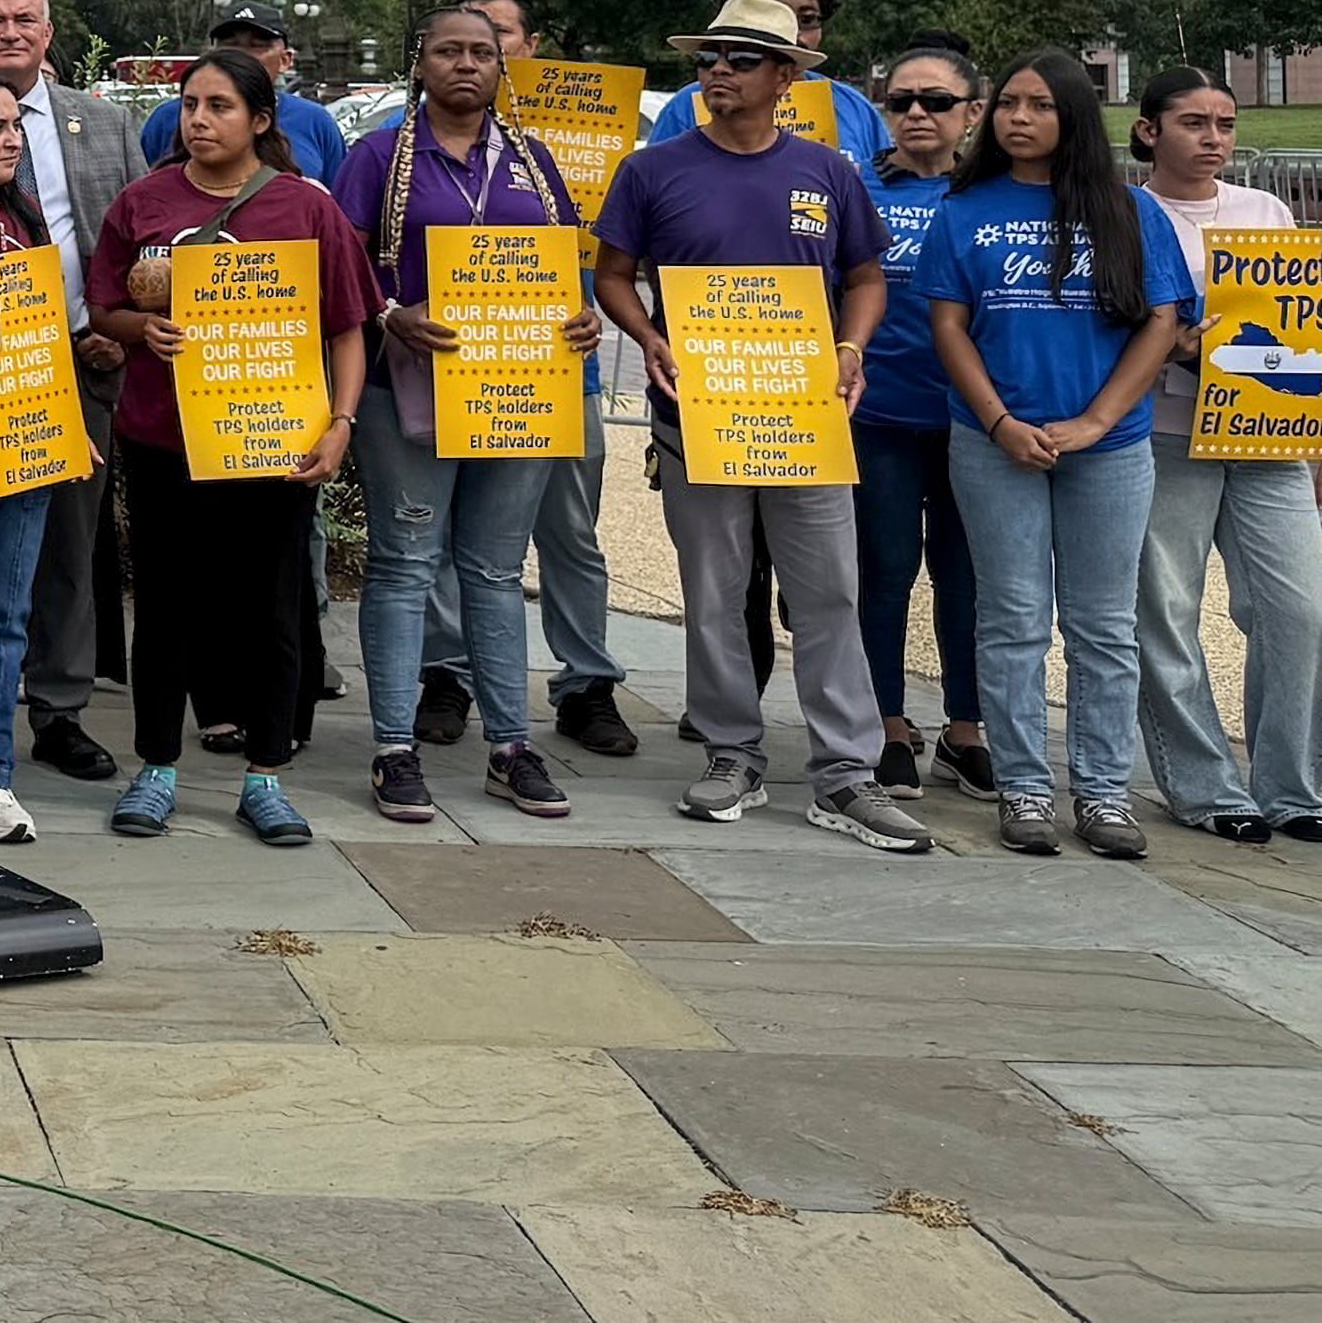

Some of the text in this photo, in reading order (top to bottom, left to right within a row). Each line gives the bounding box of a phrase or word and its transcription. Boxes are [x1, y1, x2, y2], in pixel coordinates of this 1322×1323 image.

[541, 66, 603, 85] 25 years
[535, 80, 603, 102] of calling
[543, 95, 573, 112] U.S.
[576, 98, 618, 116] home
[543, 128, 623, 154] FAMILIES
[558, 148, 605, 166] LIVES
[790, 190, 828, 206] 32BJ
[790, 218, 827, 234] SEIU
[888, 217, 920, 230] TPS
[471, 234, 536, 252] 25 years
[1004, 233, 1039, 245] TPS
[213, 251, 276, 270] 25 years
[469, 250, 539, 269] of calling
[1211, 249, 1322, 286] Protec
[211, 265, 280, 285] of calling
[452, 267, 558, 283] the U.S. home
[706, 274, 776, 291] 25 years
[17, 293, 47, 308] home
[194, 283, 297, 303] the U.S. home
[706, 289, 781, 307] of calling
[444, 304, 569, 322] OUR FAMILIES
[690, 305, 803, 321] the U.S. home
[185, 321, 307, 340] OUR FAMILIES
[459, 324, 553, 341] OUR LIVES
[2, 327, 58, 358] FAMILIES
[204, 341, 293, 361] OUR LIVES
[684, 338, 821, 357] OUR FAMILIES
[17, 347, 50, 368] LIVES
[459, 344, 553, 361] OUR FIGHT
[204, 360, 294, 382] OUR FIGHT
[704, 357, 806, 375] OUR LIVES
[20, 367, 53, 387] FIGHT
[705, 376, 808, 394] OUR FIGHT
[481, 383, 535, 397] Protect
[1204, 383, 1240, 407] for
[227, 399, 285, 417] Protect
[464, 399, 553, 415] TPS holders
[8, 408, 49, 431] Protect
[213, 417, 304, 435] TPS holders
[491, 416, 527, 432] from
[732, 413, 793, 427] Protect
[1200, 411, 1322, 437] El Salvado
[21, 421, 63, 445] holders
[470, 433, 551, 449] El Salvador
[714, 428, 815, 444] TPS holders
[244, 435, 282, 451] from
[20, 447, 47, 463] from
[223, 454, 237, 470] El
[746, 447, 787, 460] from
[5, 459, 67, 485] El Salvador
[723, 462, 817, 477] El Salvador
